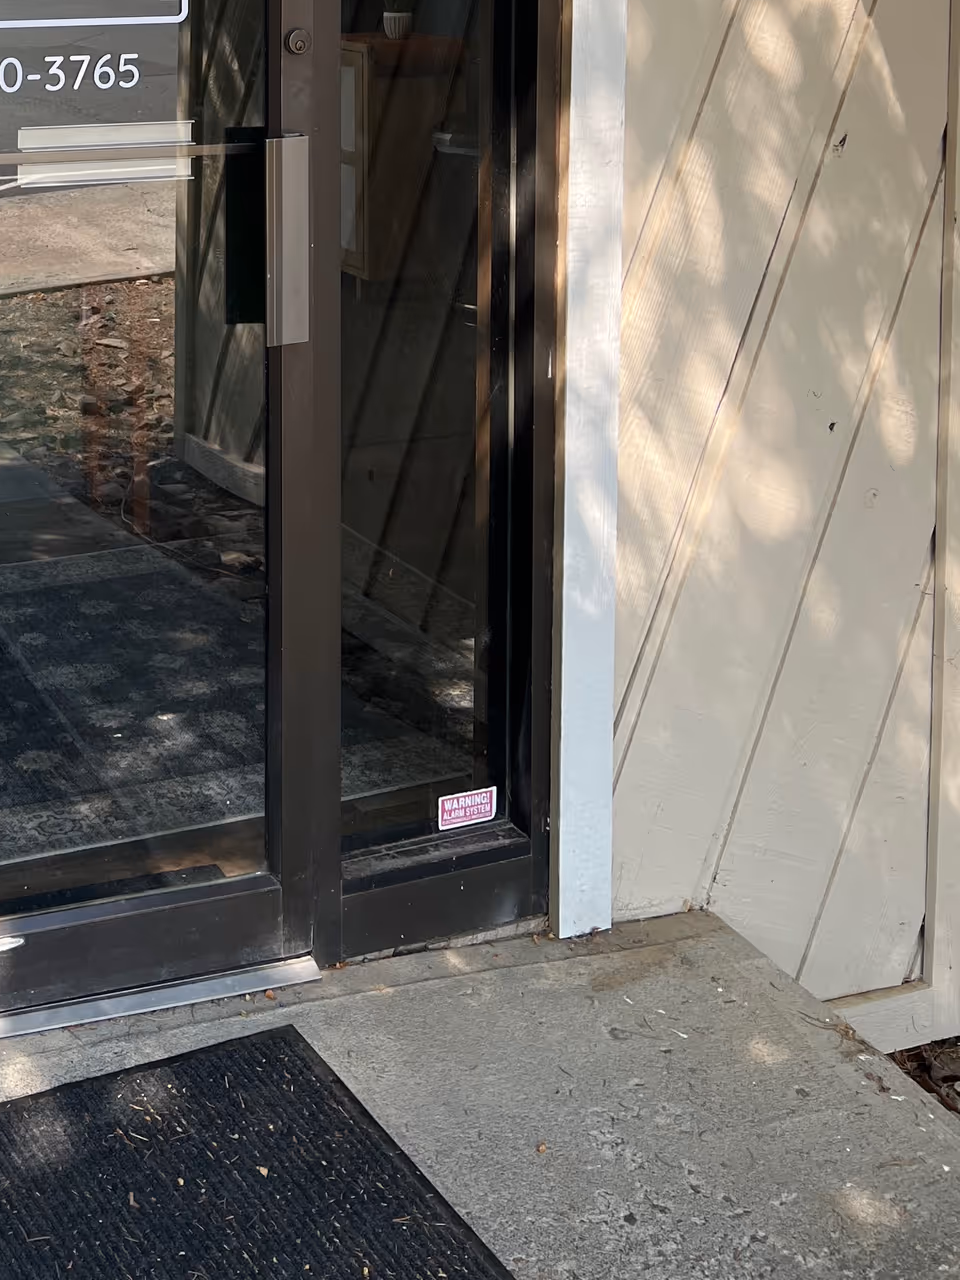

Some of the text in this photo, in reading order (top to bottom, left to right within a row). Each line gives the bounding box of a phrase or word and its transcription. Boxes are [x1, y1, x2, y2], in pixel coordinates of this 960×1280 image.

[444, 791, 490, 811] WARNING!
[443, 808, 465, 820] ALARM
[466, 803, 491, 816] SYSTEM
